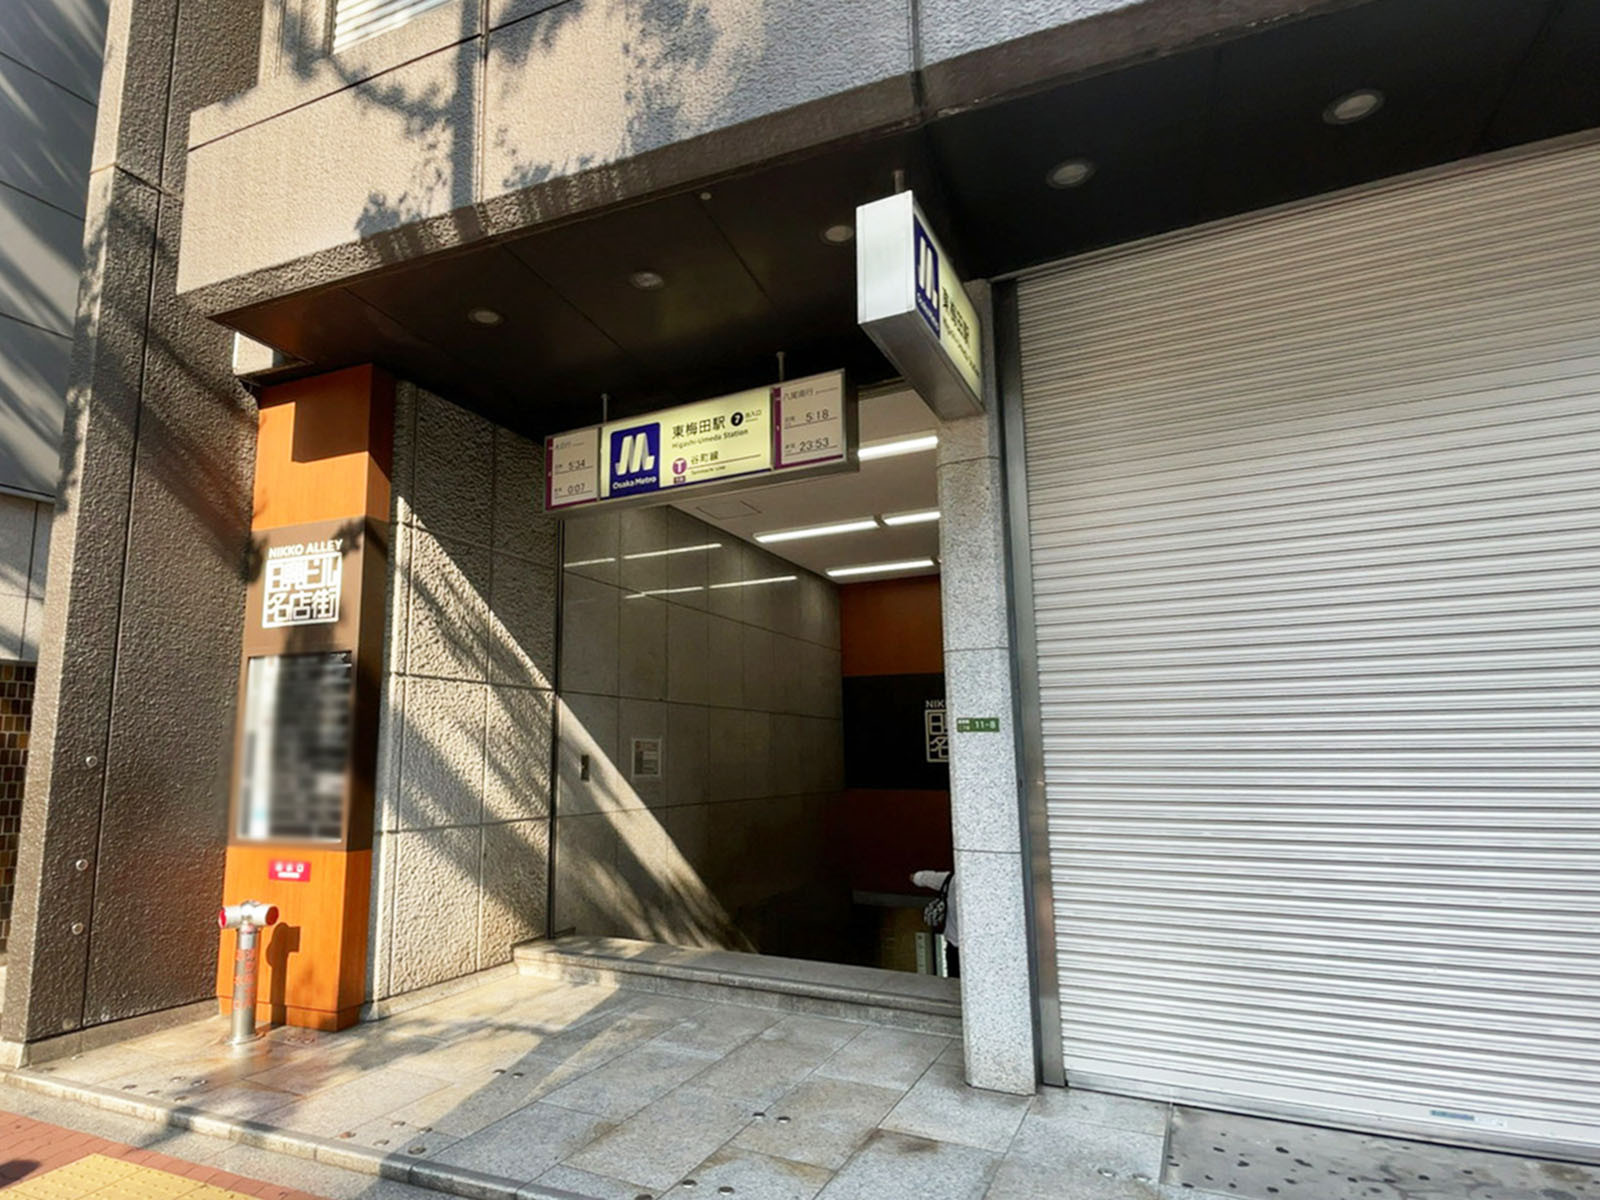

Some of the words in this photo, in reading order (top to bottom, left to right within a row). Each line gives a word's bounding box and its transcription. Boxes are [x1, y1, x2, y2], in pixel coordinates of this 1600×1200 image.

[672, 415, 726, 440] 東梅田駅
[723, 428, 748, 440] Station
[691, 450, 719, 465] 谷町線
[612, 481, 634, 489] Osaka
[635, 476, 657, 485] Metro
[268, 544, 304, 558] NIKKO
[306, 539, 343, 554] ALLEY
[266, 588, 338, 622] 名店街
[929, 713, 947, 735] 日
